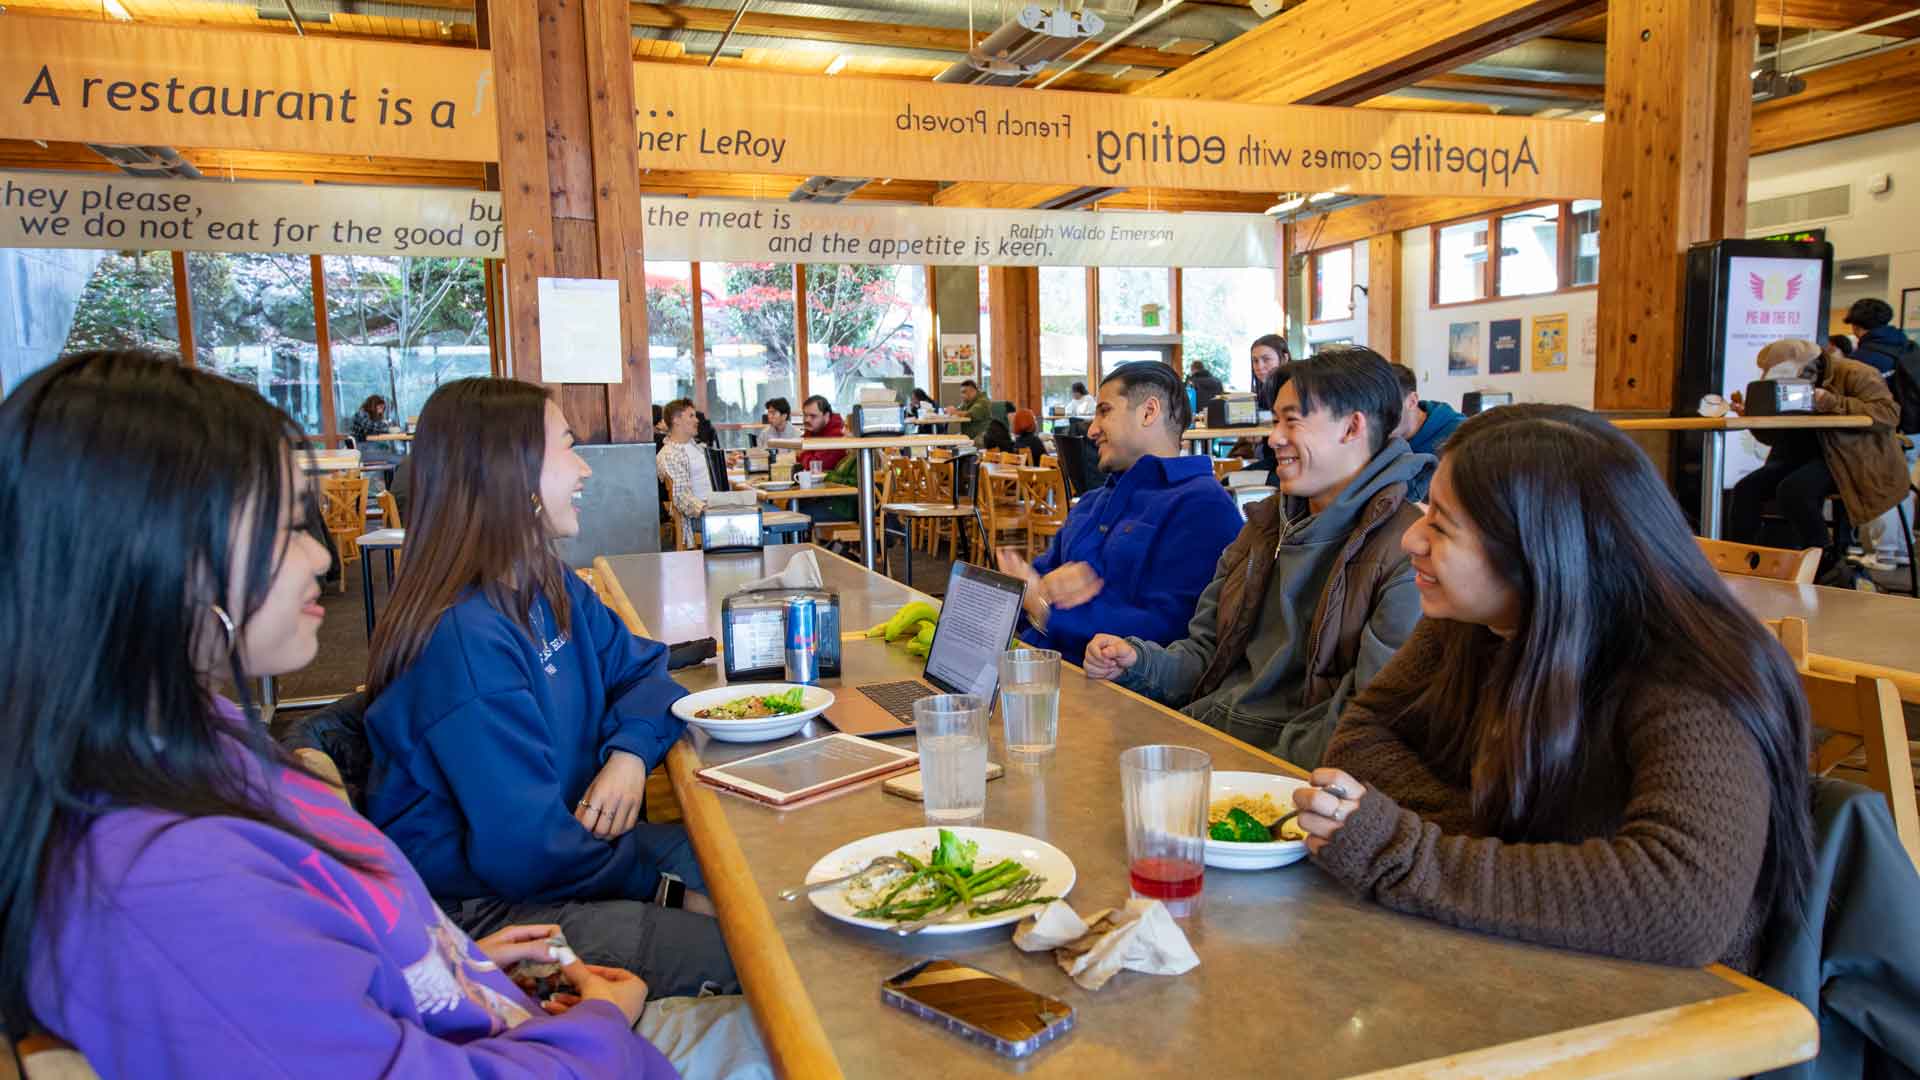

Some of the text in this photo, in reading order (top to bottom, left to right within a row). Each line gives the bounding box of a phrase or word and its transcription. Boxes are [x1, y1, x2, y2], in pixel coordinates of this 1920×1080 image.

[22, 64, 456, 129] A restaurant is a
[638, 127, 787, 164] ner LeRoy
[0, 180, 203, 218] hey please,
[469, 198, 503, 222] bu
[20, 211, 504, 252] we do not eat for the good of
[648, 205, 689, 227] the
[698, 209, 763, 230] meat
[772, 208, 791, 230] is
[1010, 223, 1174, 241] Ralph Waldo Emerson
[768, 231, 1054, 260] and the appetite is keen.
